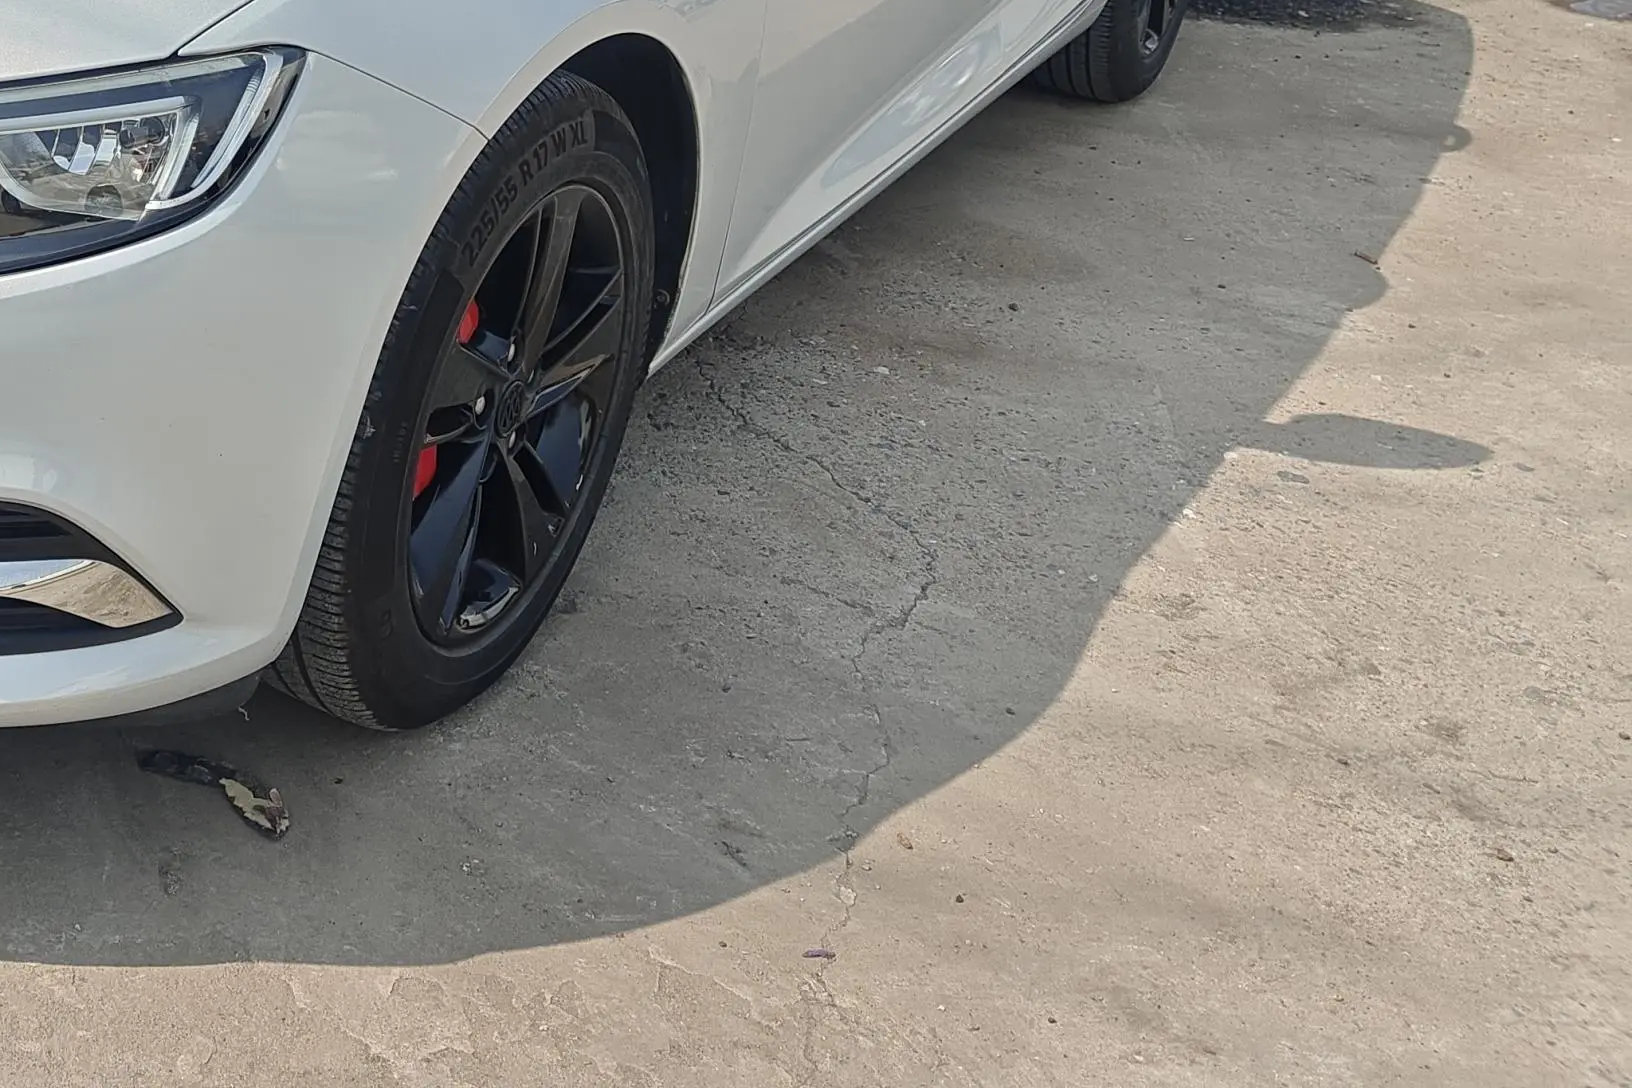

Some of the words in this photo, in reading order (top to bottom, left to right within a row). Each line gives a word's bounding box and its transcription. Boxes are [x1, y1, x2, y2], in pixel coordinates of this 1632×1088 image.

[460, 174, 518, 268] 225/55
[550, 126, 568, 157] W
[569, 119, 589, 150] XL
